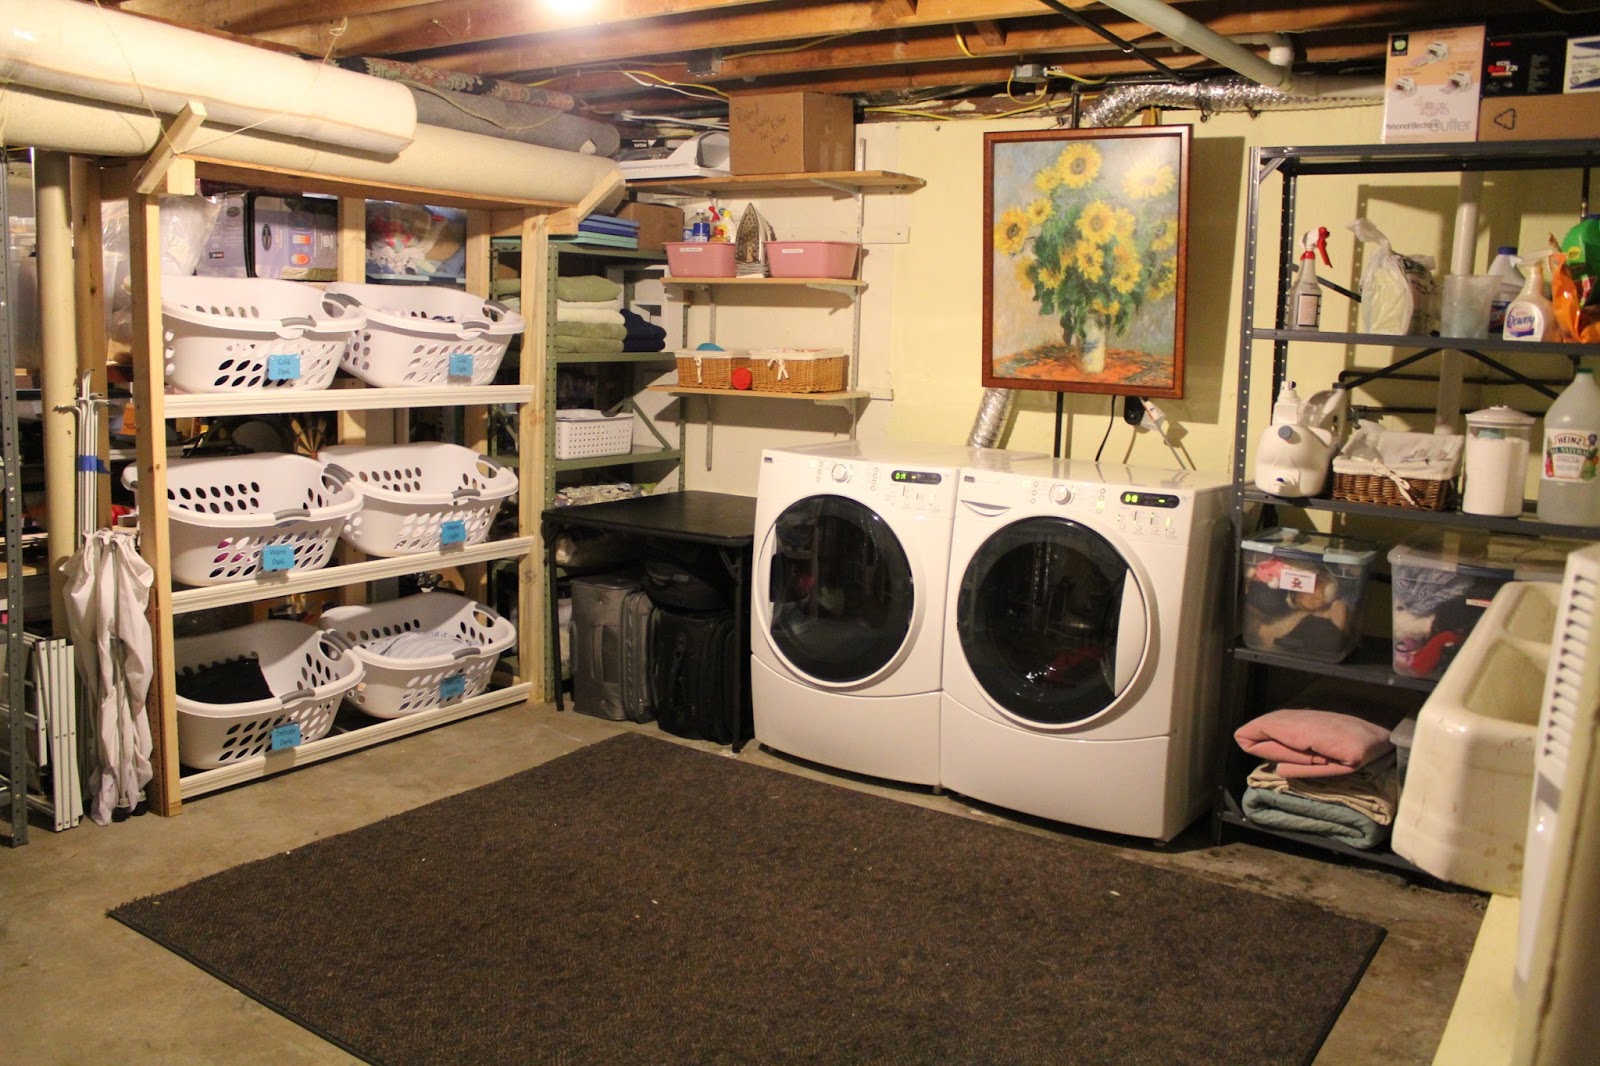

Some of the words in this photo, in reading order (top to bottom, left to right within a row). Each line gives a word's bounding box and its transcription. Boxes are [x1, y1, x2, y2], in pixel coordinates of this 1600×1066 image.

[1428, 118, 1472, 132] Cutter
[1506, 314, 1535, 328] Downy
[277, 357, 291, 365] Cold
[1557, 436, 1582, 445] HEINZ
